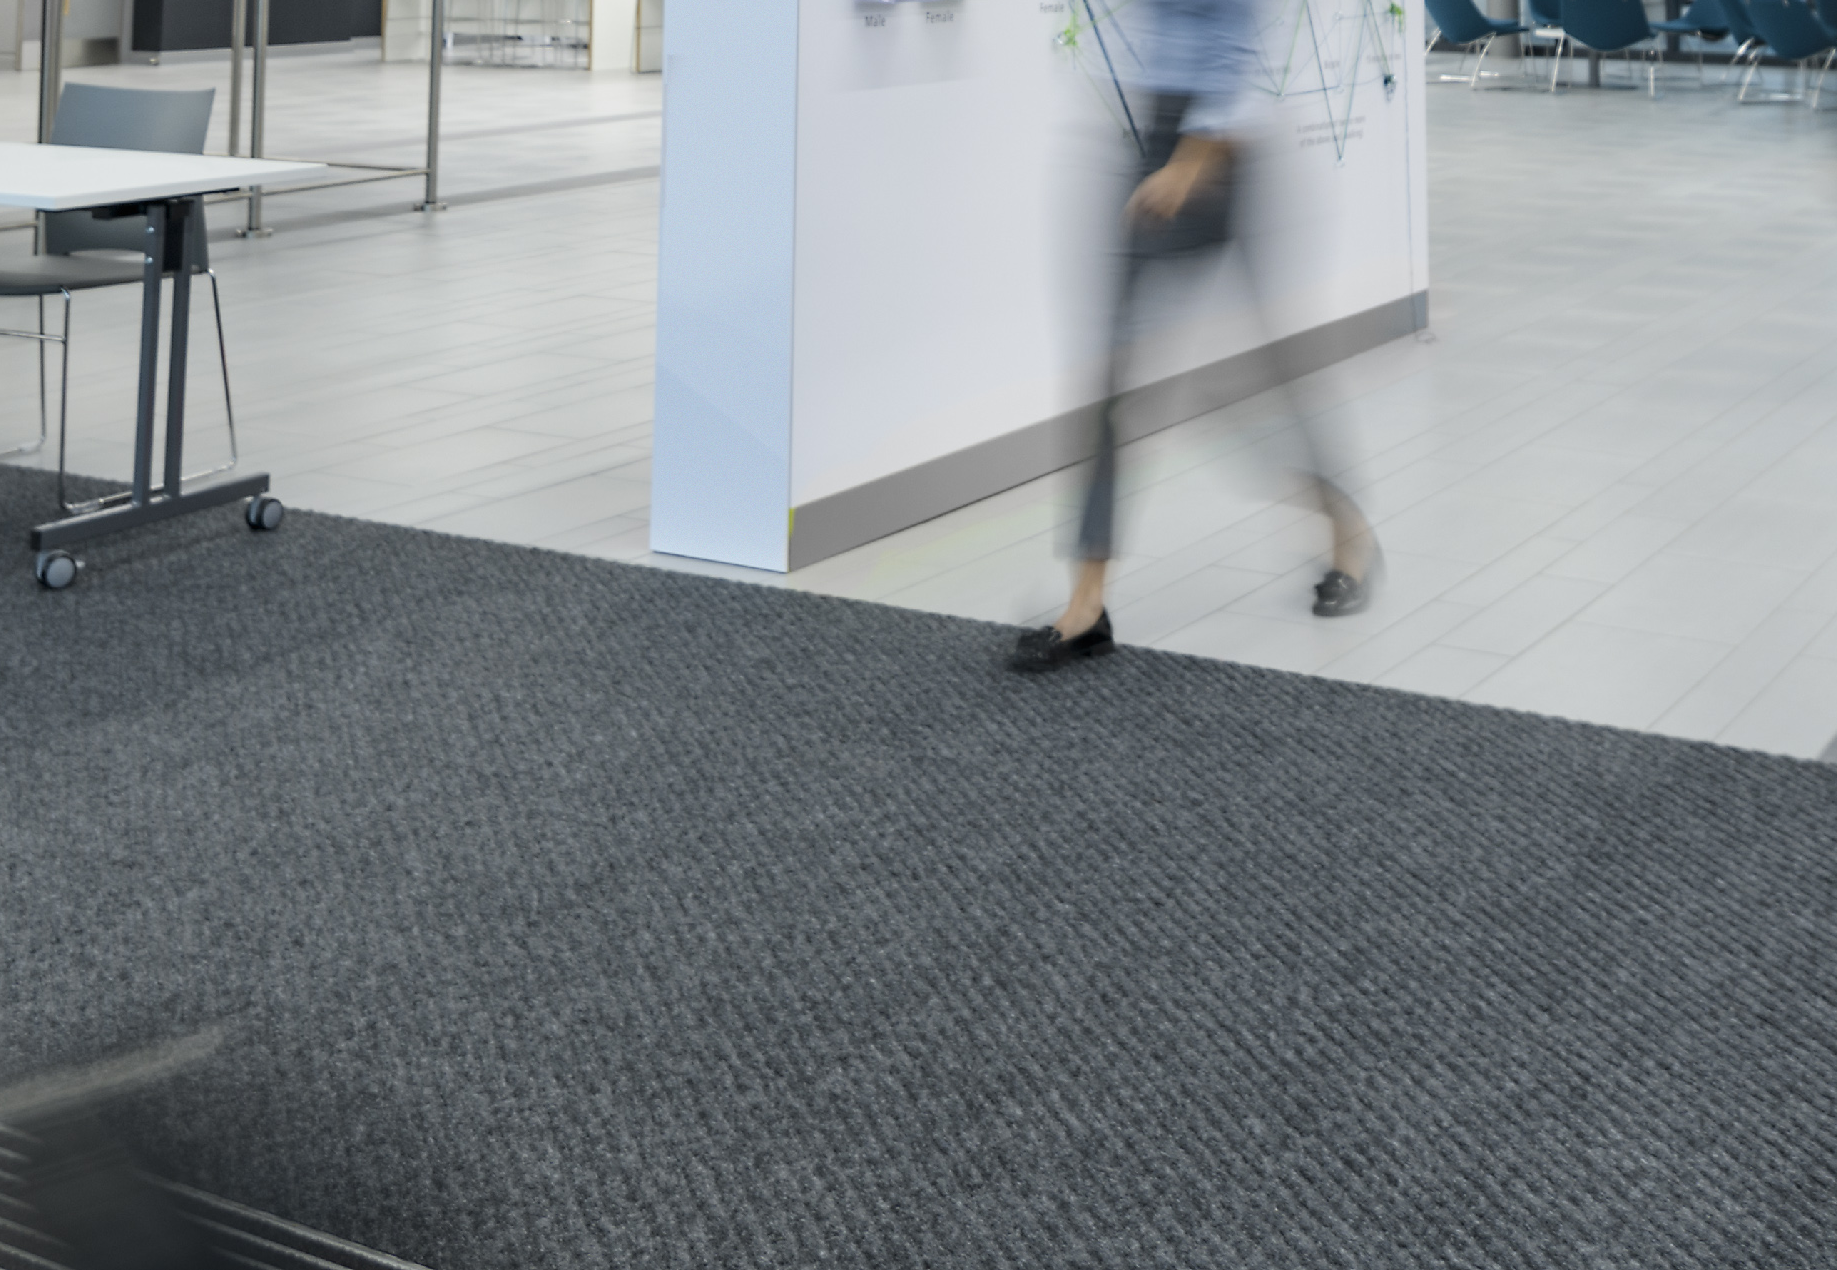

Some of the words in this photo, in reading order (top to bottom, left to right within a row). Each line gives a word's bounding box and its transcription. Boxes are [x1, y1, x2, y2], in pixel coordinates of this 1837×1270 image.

[1040, 2, 1064, 14] Female
[865, 14, 886, 28] Male
[925, 11, 954, 25] Female
